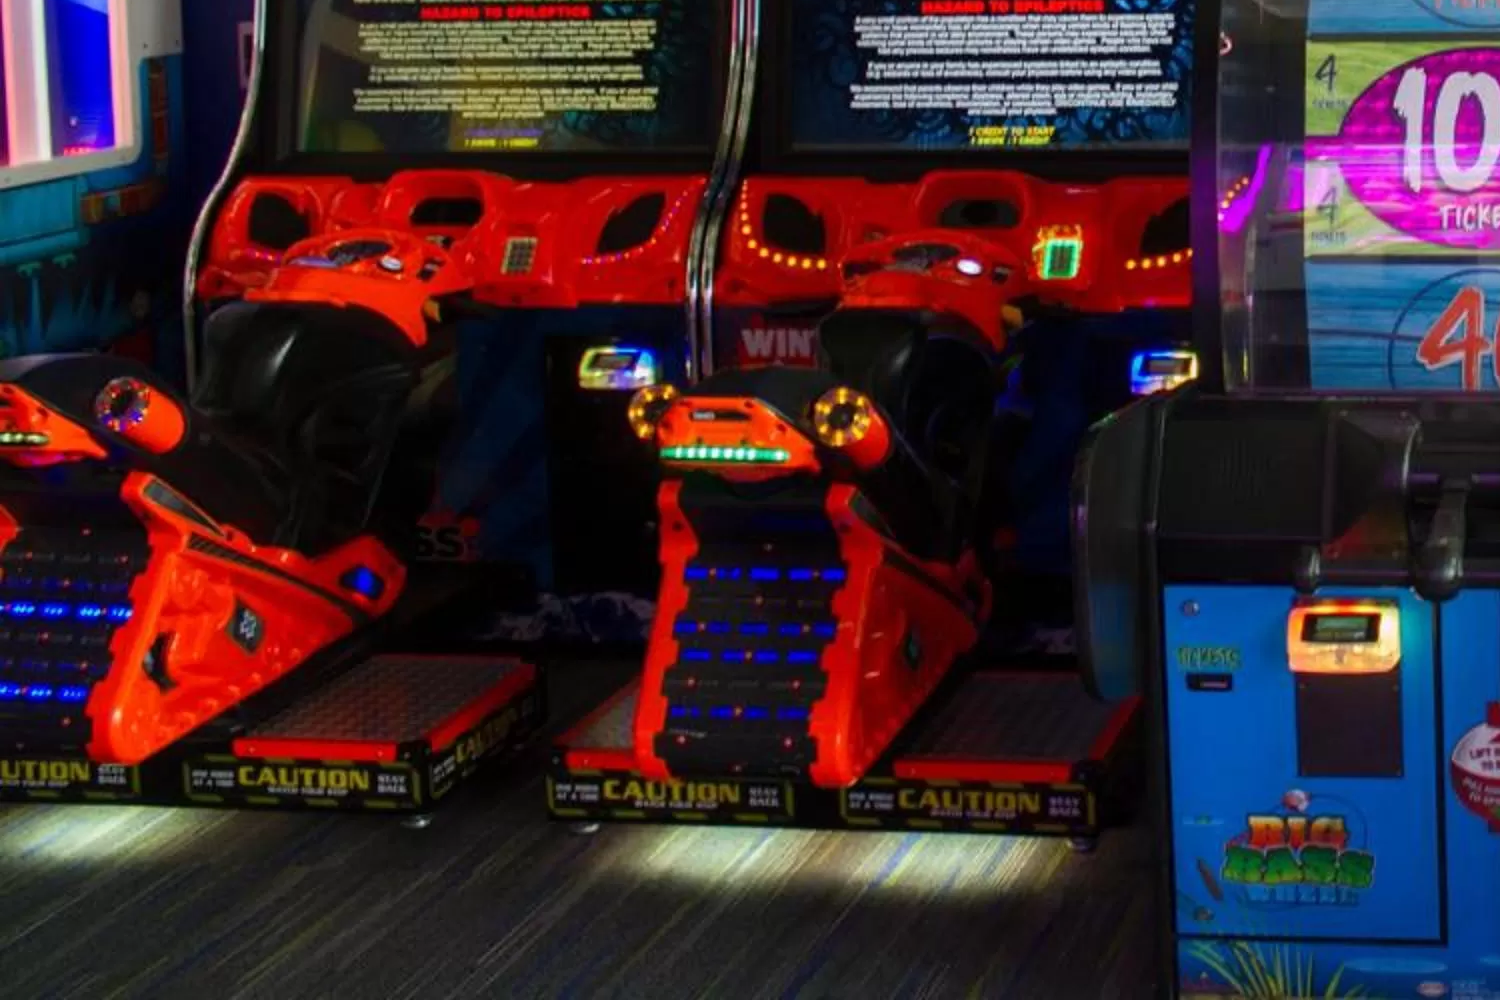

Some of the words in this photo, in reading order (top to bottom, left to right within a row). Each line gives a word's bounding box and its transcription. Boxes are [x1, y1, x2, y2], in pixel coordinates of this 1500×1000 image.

[1315, 54, 1336, 91] 4
[1316, 186, 1338, 224] 4
[741, 328, 816, 358] WIN
[0, 760, 90, 781] UTION
[238, 766, 370, 790] CAUTION
[603, 779, 740, 803] CAUTION
[899, 788, 1041, 814] CAUTION
[1220, 845, 1376, 889] BASS
